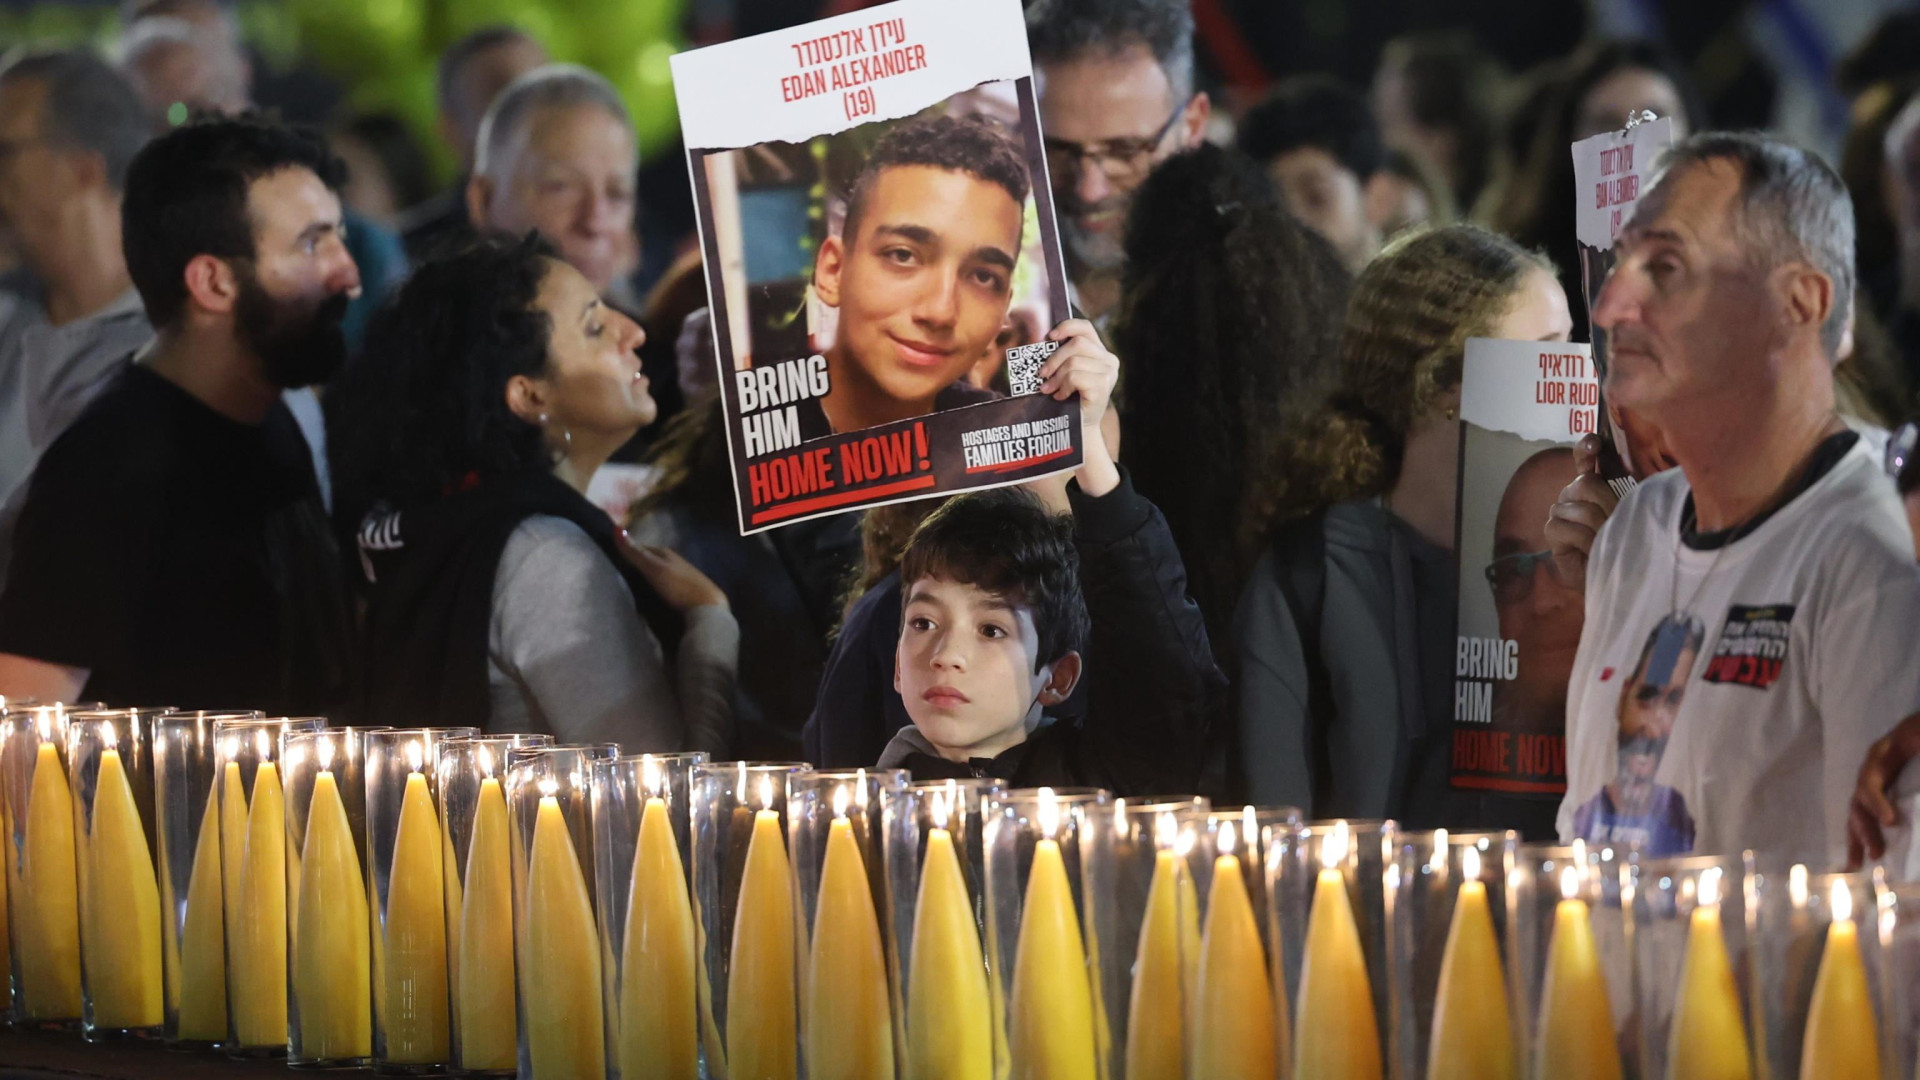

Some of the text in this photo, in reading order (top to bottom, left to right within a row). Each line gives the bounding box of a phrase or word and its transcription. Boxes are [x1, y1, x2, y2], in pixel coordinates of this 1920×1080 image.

[791, 18, 905, 68] עידן אלכסנדר
[781, 44, 927, 102] EDAN ALEXANDER
[843, 86, 876, 121] (19)
[736, 354, 830, 414] BRING
[1539, 353, 1584, 379] רודאיף
[1536, 381, 1598, 406] LIOR RUD
[742, 405, 801, 458] HIM
[961, 414, 1070, 447] HOSTAGES AND MISSING
[1569, 408, 1595, 435] (61)
[748, 422, 931, 506] HOME NOW!
[964, 429, 1071, 468] FAMILIES FORUM
[1456, 636, 1519, 680] BRING
[1454, 681, 1493, 723] HIM
[1453, 729, 1510, 773] HOME
